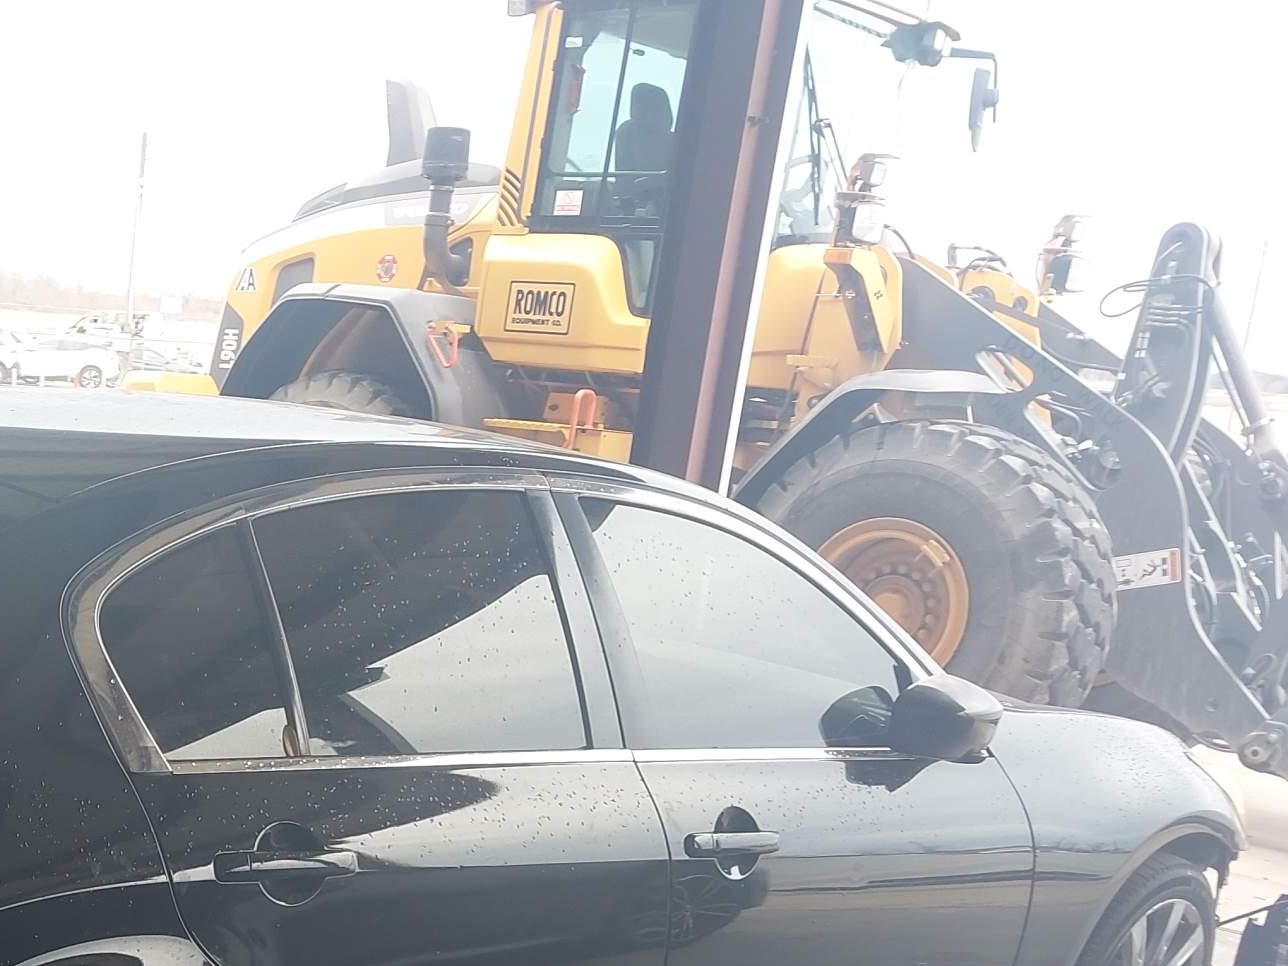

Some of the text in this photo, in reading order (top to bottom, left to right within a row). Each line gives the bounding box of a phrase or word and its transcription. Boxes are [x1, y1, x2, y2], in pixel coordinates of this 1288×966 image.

[513, 289, 567, 317] ROMCO
[511, 317, 550, 326] EQUIPMENT
[218, 328, 240, 370] L90H
